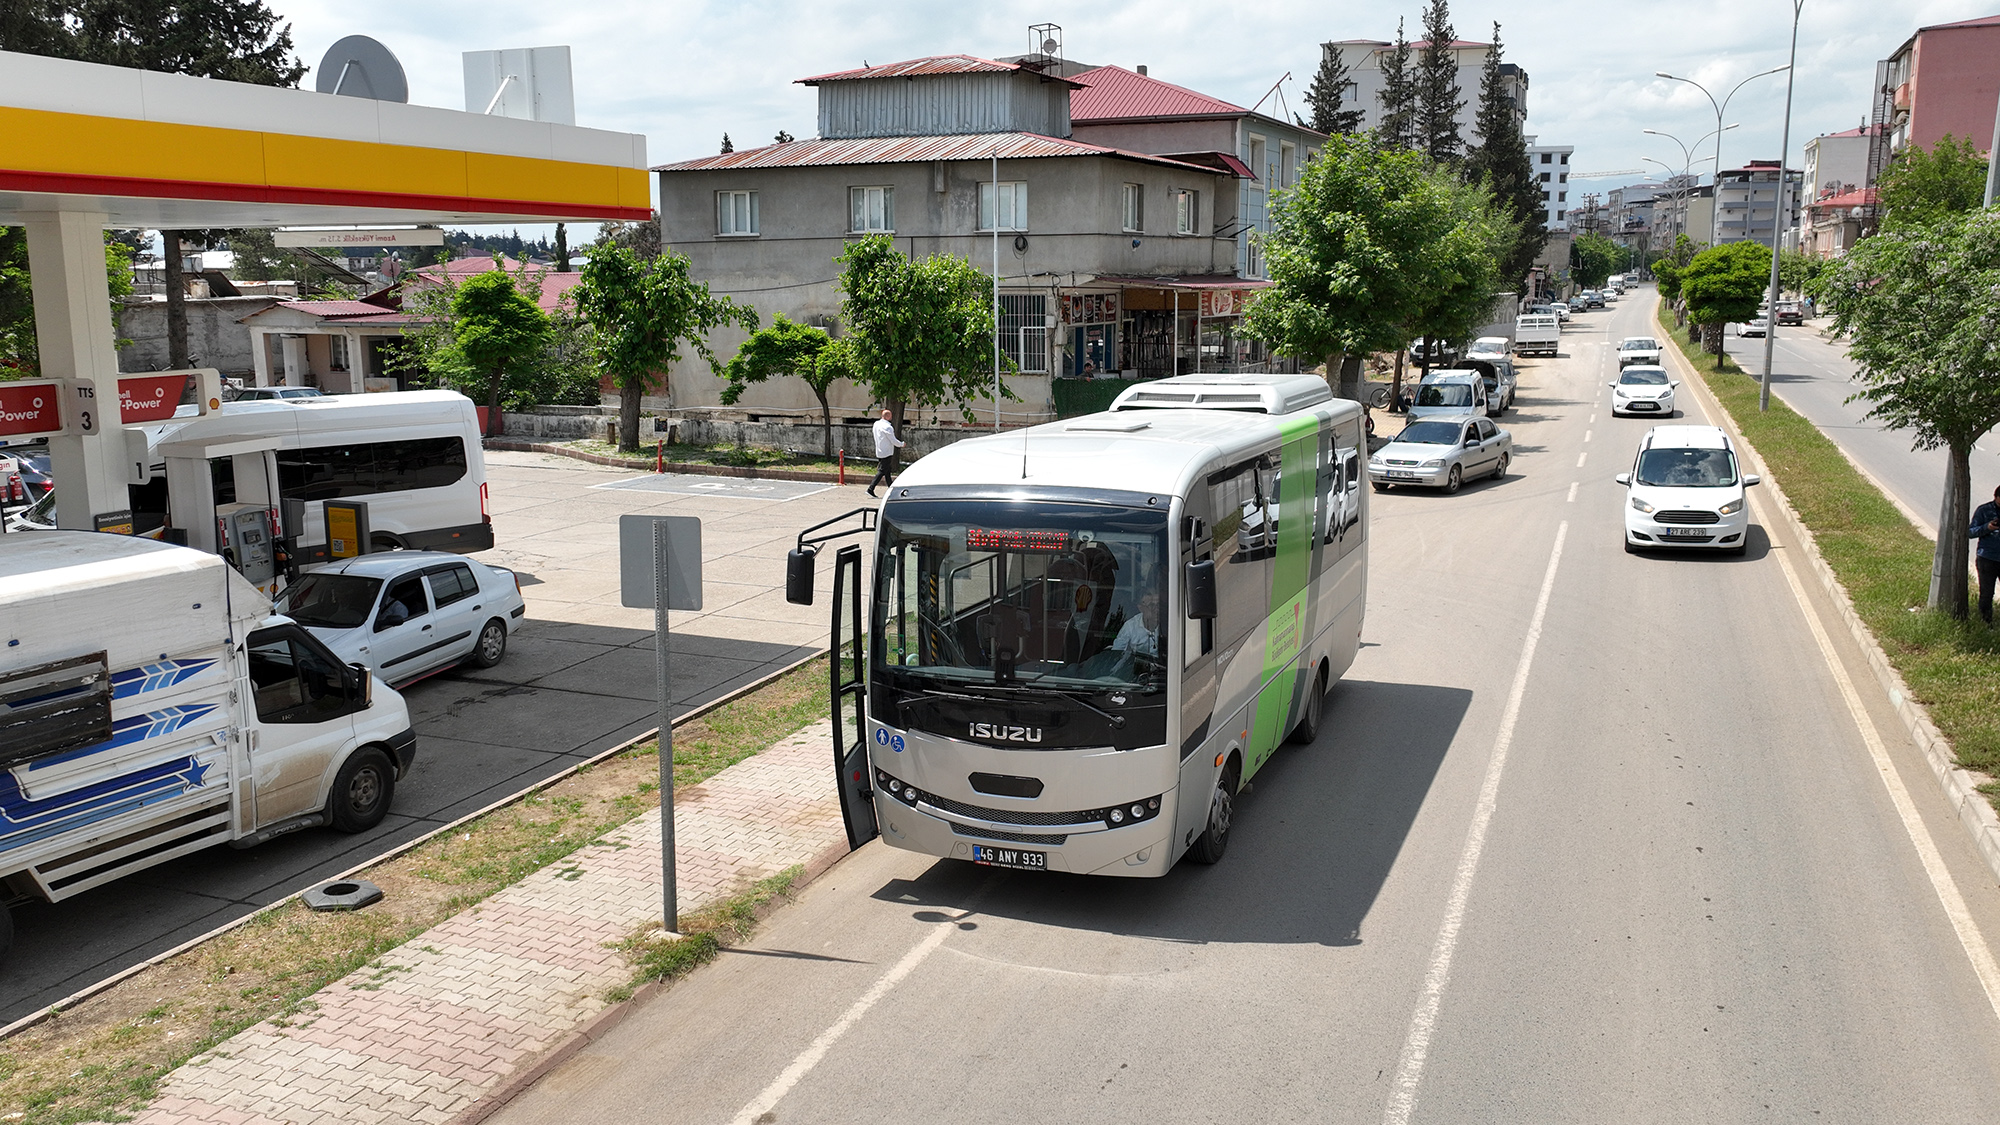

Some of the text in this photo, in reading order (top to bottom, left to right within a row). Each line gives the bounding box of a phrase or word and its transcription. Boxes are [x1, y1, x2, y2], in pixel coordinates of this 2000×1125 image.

[77, 387, 94, 398] TTS
[119, 399, 161, 410] -Power
[81, 411, 92, 430] 3
[135, 462, 143, 479] 1
[969, 722, 1042, 742] ISUZU
[980, 848, 1044, 866] 46 ANY 933
